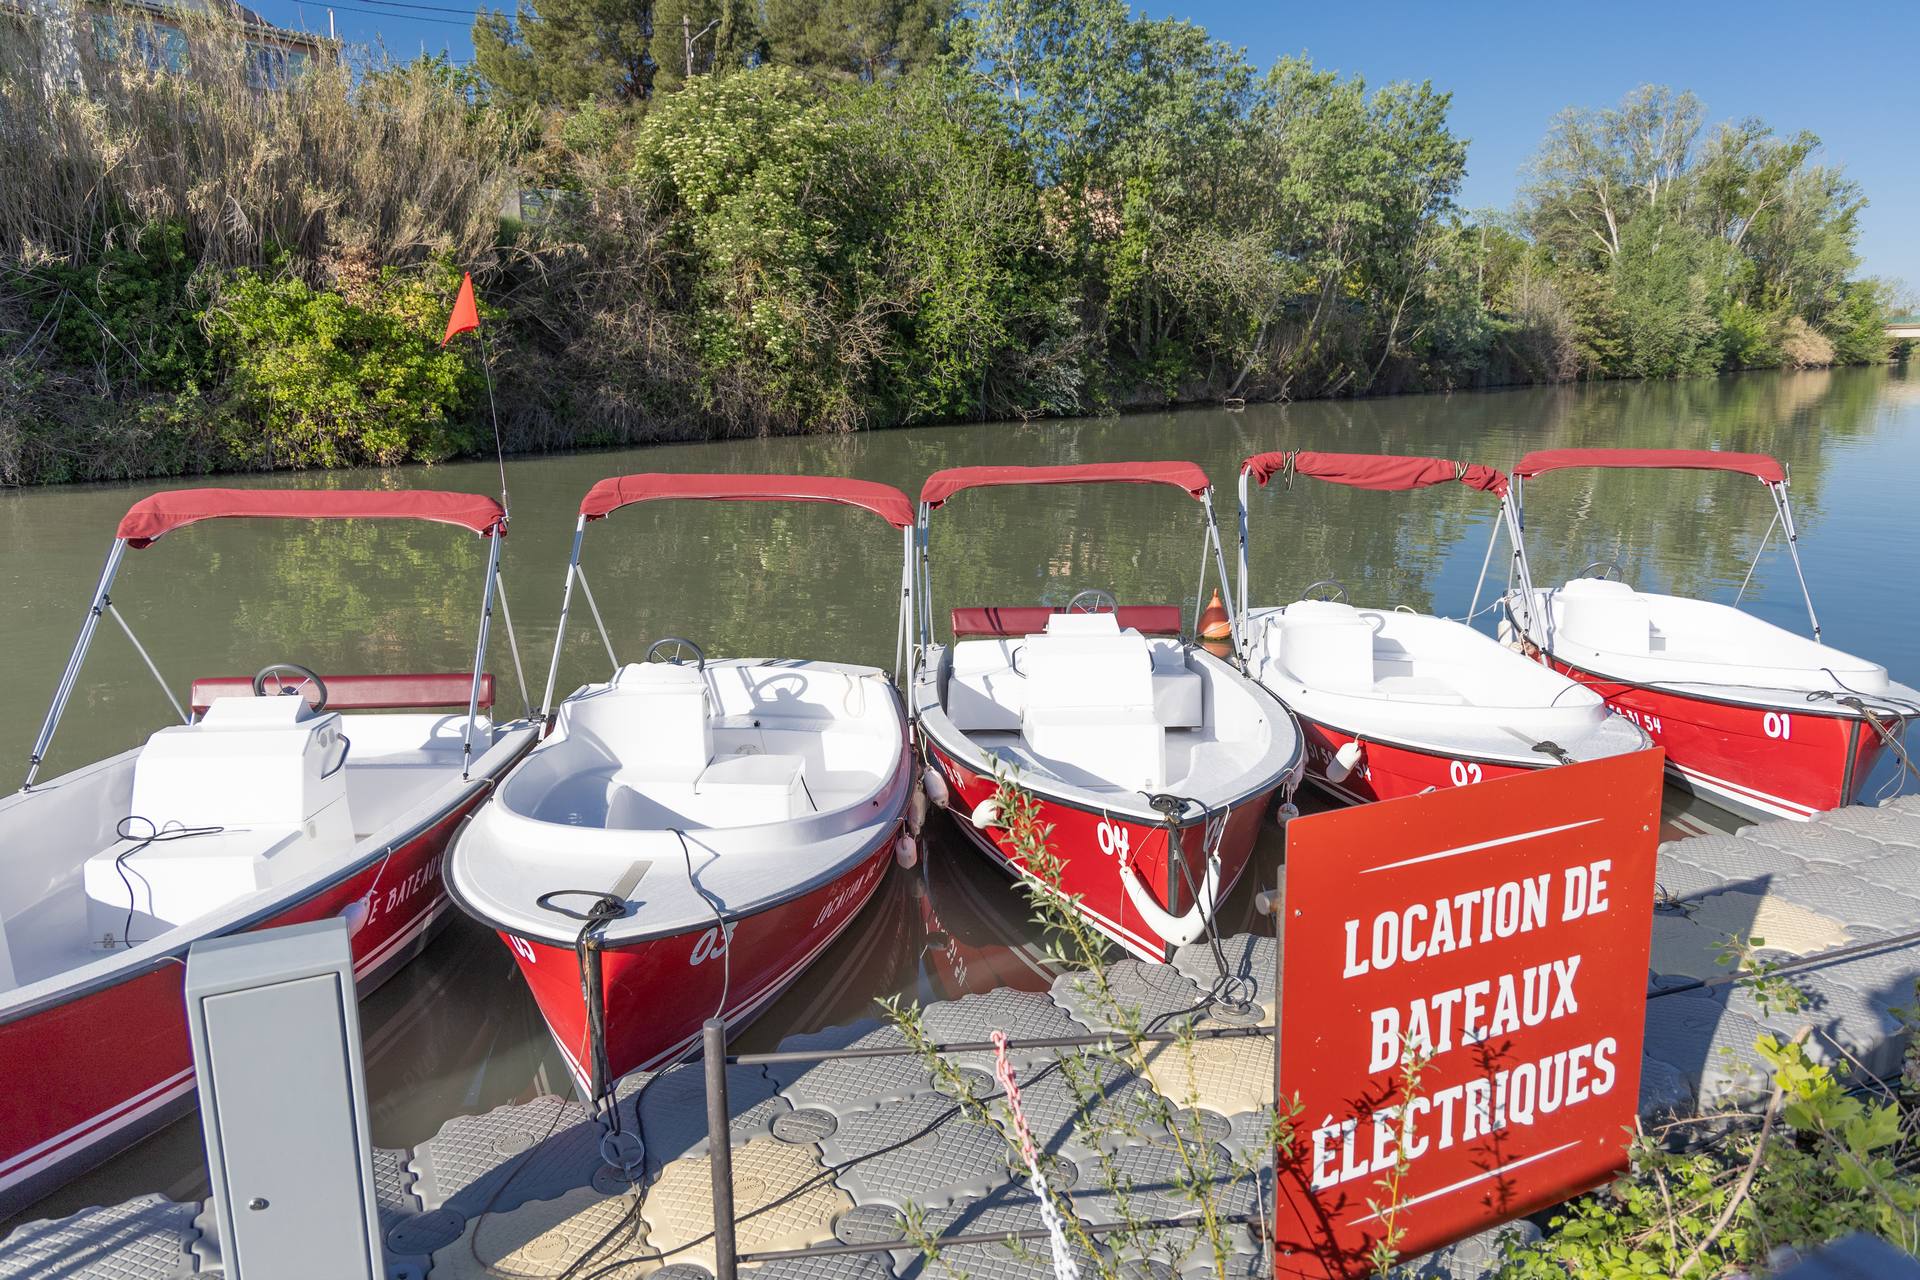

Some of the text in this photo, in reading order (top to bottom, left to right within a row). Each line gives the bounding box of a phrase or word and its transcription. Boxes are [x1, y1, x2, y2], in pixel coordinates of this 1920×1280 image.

[1643, 714, 1662, 735] 54
[1763, 711, 1791, 740] 01
[1450, 760, 1483, 788] 02
[1096, 821, 1130, 862] 04
[1342, 858, 1613, 980] LOCATION DE
[690, 920, 739, 966] 03
[1368, 954, 1582, 1075] BATEAUX
[1310, 1037, 1617, 1191] ÉLECTRIQUES
